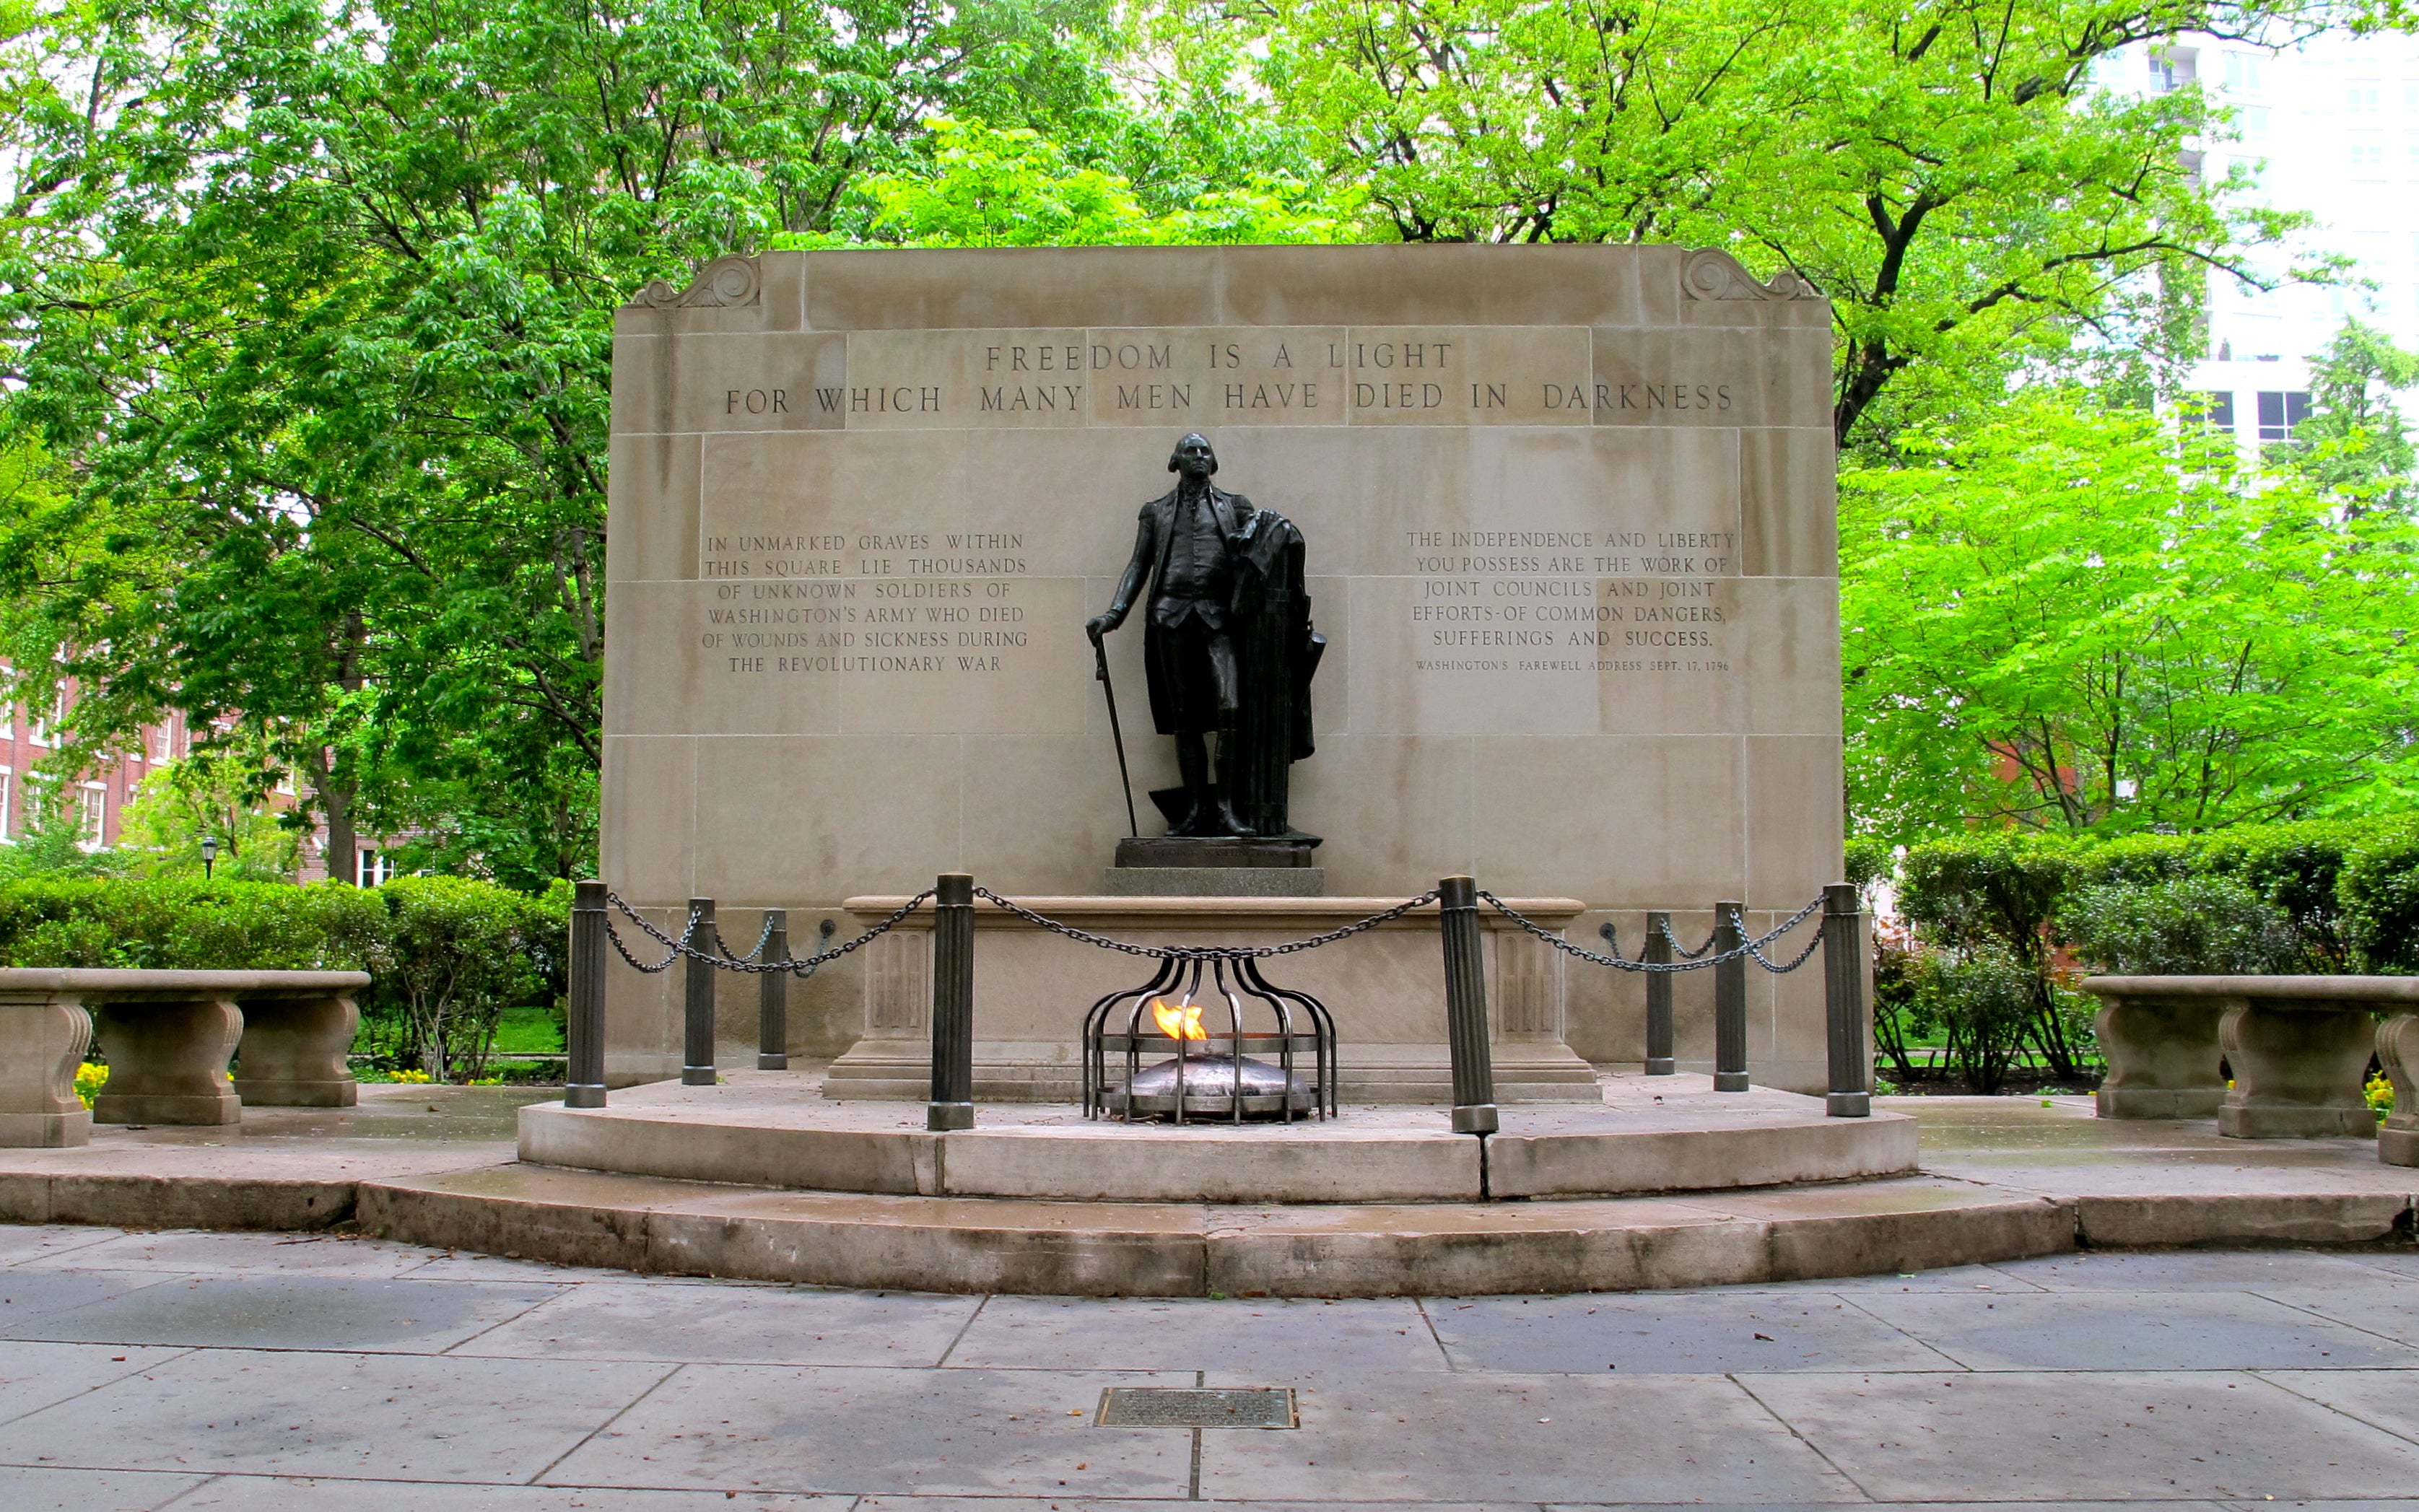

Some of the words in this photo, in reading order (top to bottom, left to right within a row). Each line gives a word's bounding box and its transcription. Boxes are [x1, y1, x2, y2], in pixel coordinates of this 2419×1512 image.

[987, 345, 1172, 372] FREEDOM
[1210, 344, 1240, 369] IS
[1273, 343, 1293, 368] A
[1329, 343, 1452, 369] LIGHT
[725, 388, 790, 414] FOR
[816, 387, 941, 413] WHICH
[980, 385, 1084, 411] MANY
[1117, 384, 1192, 410] MEN
[1224, 384, 1318, 410] HAVE
[1354, 383, 1443, 409] DIED
[1471, 383, 1507, 409] IN
[1543, 383, 1733, 410] DARKNESS
[708, 537, 727, 551] IN
[740, 536, 845, 551] UNMARKED
[859, 536, 929, 550] GRAVES
[947, 534, 1023, 549] WITHIN
[1407, 533, 1442, 547] THE
[1452, 533, 1592, 548] INDEPENDENCE
[1605, 533, 1646, 548] AND
[1658, 533, 1735, 548] LIBERTY
[705, 561, 749, 576] THIS
[766, 559, 841, 577] SQUARE
[862, 559, 891, 574] LIE
[910, 558, 1027, 574] THOUSANDS
[1418, 557, 1454, 572] YOU
[1463, 557, 1539, 572] POSSESS
[1548, 557, 1585, 572] ARE
[1595, 557, 1630, 572] THE
[1642, 558, 1695, 572] WORK
[1705, 558, 1727, 572] OF
[718, 585, 741, 600] OF
[754, 584, 856, 599] UNKNOWN
[876, 583, 972, 598] SOLDIERS
[987, 582, 1010, 597] OF
[1424, 581, 1481, 599] JOINT
[1494, 582, 1592, 596] COUNCILS
[1608, 582, 1648, 596] AND
[1660, 582, 1714, 600] JOINT
[708, 606, 856, 624] WASHINGTON'S
[865, 608, 916, 623] ARMY
[927, 608, 969, 622] WHO
[980, 607, 1024, 622] DIED
[1536, 606, 1623, 621] COMMON
[1635, 607, 1726, 625] DANGERS,
[702, 634, 724, 648] OF
[733, 633, 808, 648] WOUNDS
[816, 633, 855, 647] AND
[866, 632, 948, 647] SICKNESS
[958, 632, 1028, 647] DURING
[1433, 631, 1553, 646] SUFFERINGS
[1569, 632, 1609, 646] AND
[1626, 632, 1713, 647] SUCCESS.
[729, 657, 764, 672] THE
[779, 656, 945, 672] REVOLUTIONARY
[958, 657, 1001, 671] WAR
[1416, 660, 1508, 671] WASHINGTON'S
[1520, 660, 1582, 670] FAREWELL
[1588, 661, 1641, 671] ADDRESS
[1706, 661, 1729, 671] 1796
